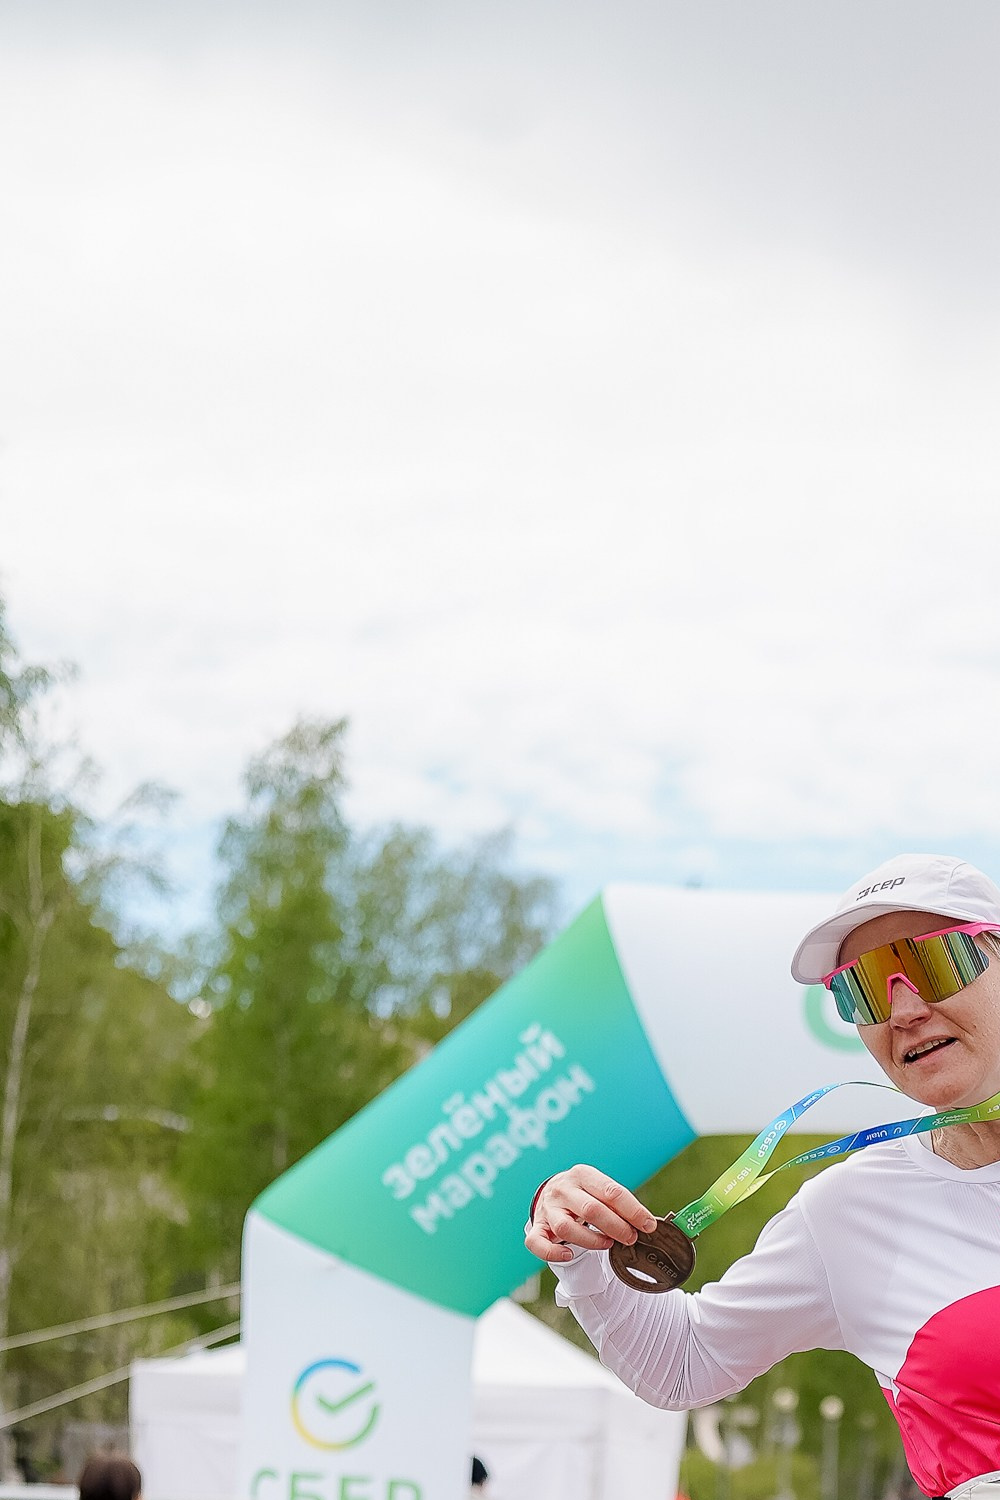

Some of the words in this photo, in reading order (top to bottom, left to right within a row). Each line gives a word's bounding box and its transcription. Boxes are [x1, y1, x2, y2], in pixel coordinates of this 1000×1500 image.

[381, 1021, 565, 1200] зелёный
[410, 1065, 596, 1235] марафон
[757, 1131, 777, 1158] СБЕР
[737, 1166, 752, 1182] 185
